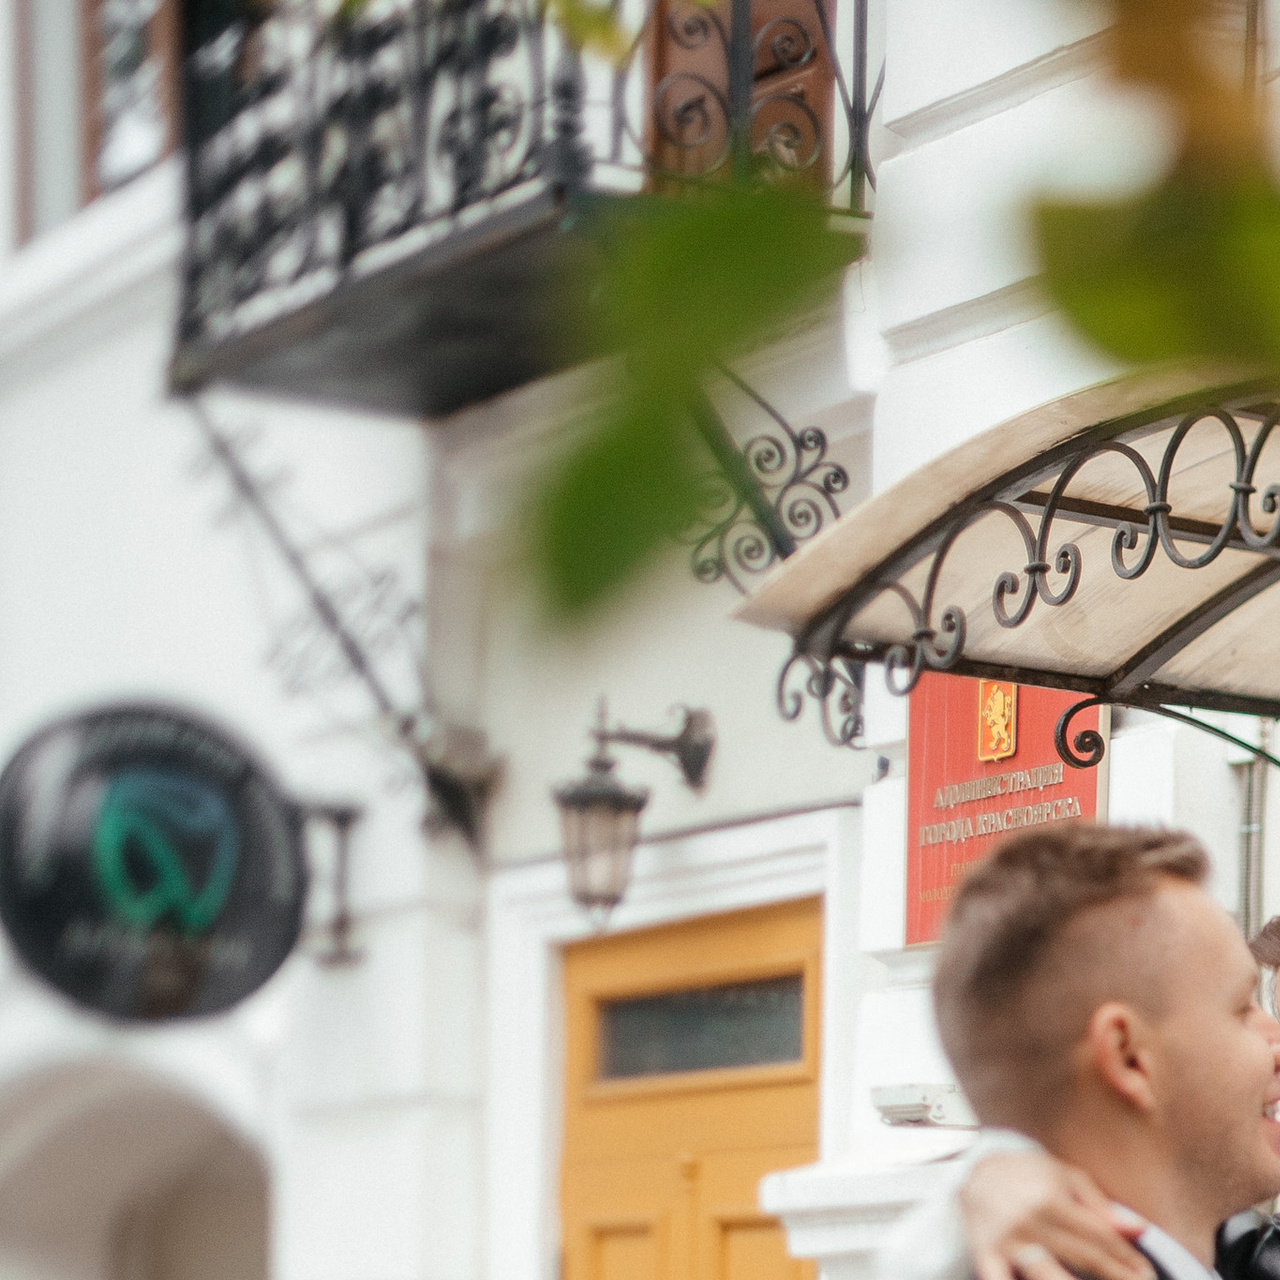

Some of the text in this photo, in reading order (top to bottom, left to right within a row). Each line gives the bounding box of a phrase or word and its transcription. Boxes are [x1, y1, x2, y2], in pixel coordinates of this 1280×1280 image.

[933, 761, 1064, 809] АДМИНИСТРАЦИЯ
[918, 796, 1082, 846] ГОРОДА КРАСНОЯРСКА
